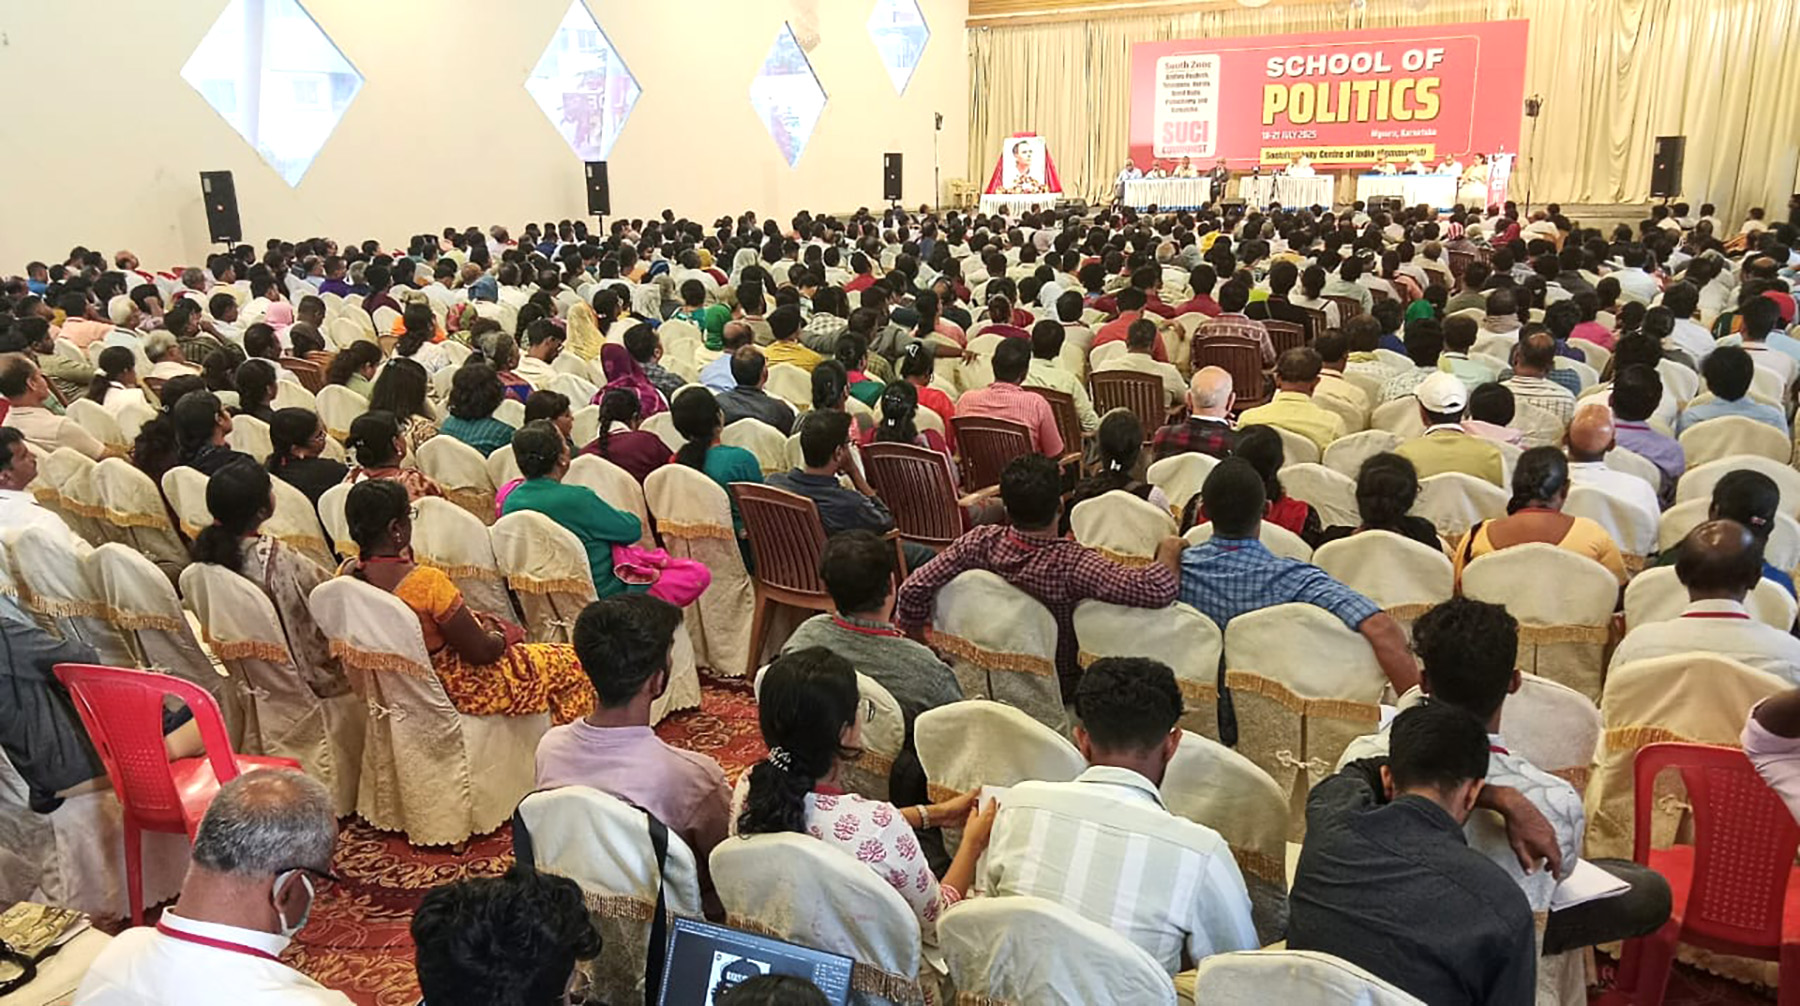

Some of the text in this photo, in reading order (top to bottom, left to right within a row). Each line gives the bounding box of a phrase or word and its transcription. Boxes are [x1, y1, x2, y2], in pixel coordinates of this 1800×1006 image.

[1266, 48, 1444, 78] SCHOOL OF
[1262, 77, 1441, 125] POLITICS
[1162, 120, 1209, 144] SUCI
[1281, 130, 1298, 140] JULY
[1319, 149, 1344, 159] Centre
[1345, 149, 1354, 158] of
[1355, 149, 1375, 158] India
